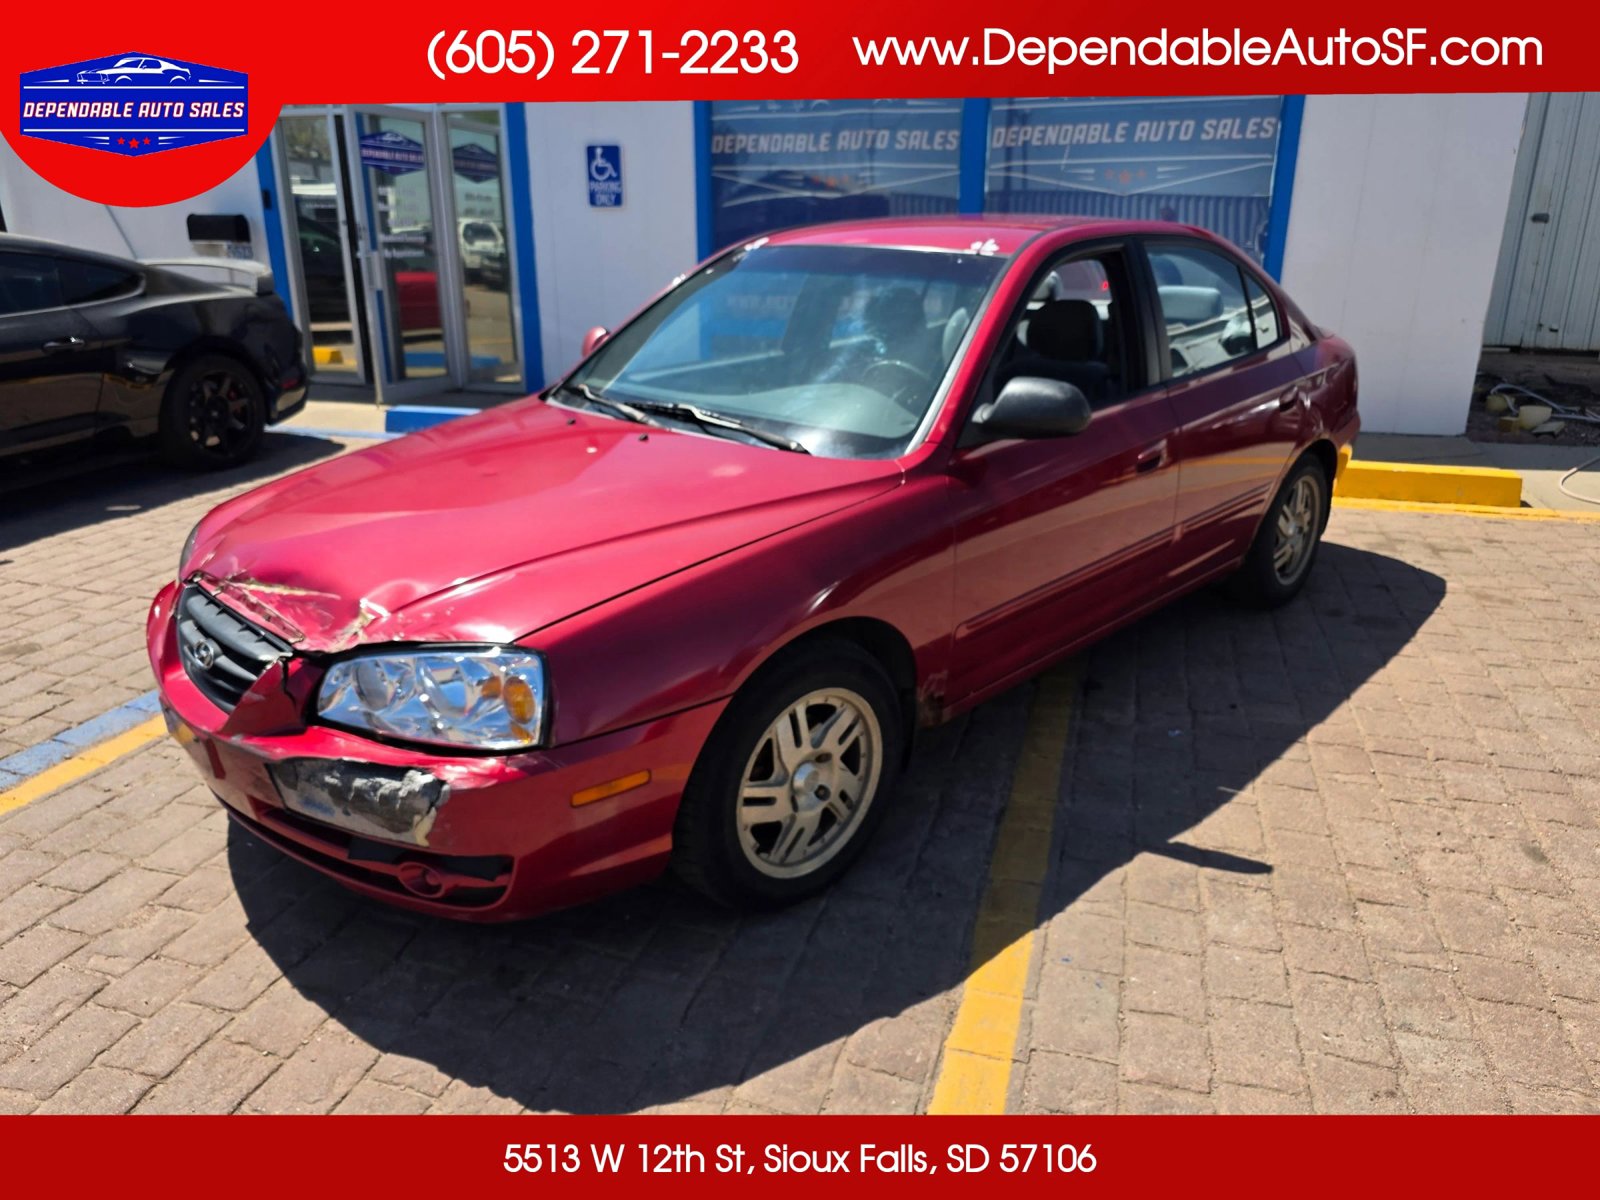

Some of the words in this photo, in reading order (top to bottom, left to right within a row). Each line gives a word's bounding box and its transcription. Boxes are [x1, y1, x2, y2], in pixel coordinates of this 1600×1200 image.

[711, 132, 832, 154] DEPENDABLE
[837, 129, 889, 151] AUTO
[895, 129, 960, 151] SALES
[991, 122, 1129, 149] DEPENDABLE
[1134, 119, 1196, 143] AUTO
[1201, 116, 1278, 140] SALES
